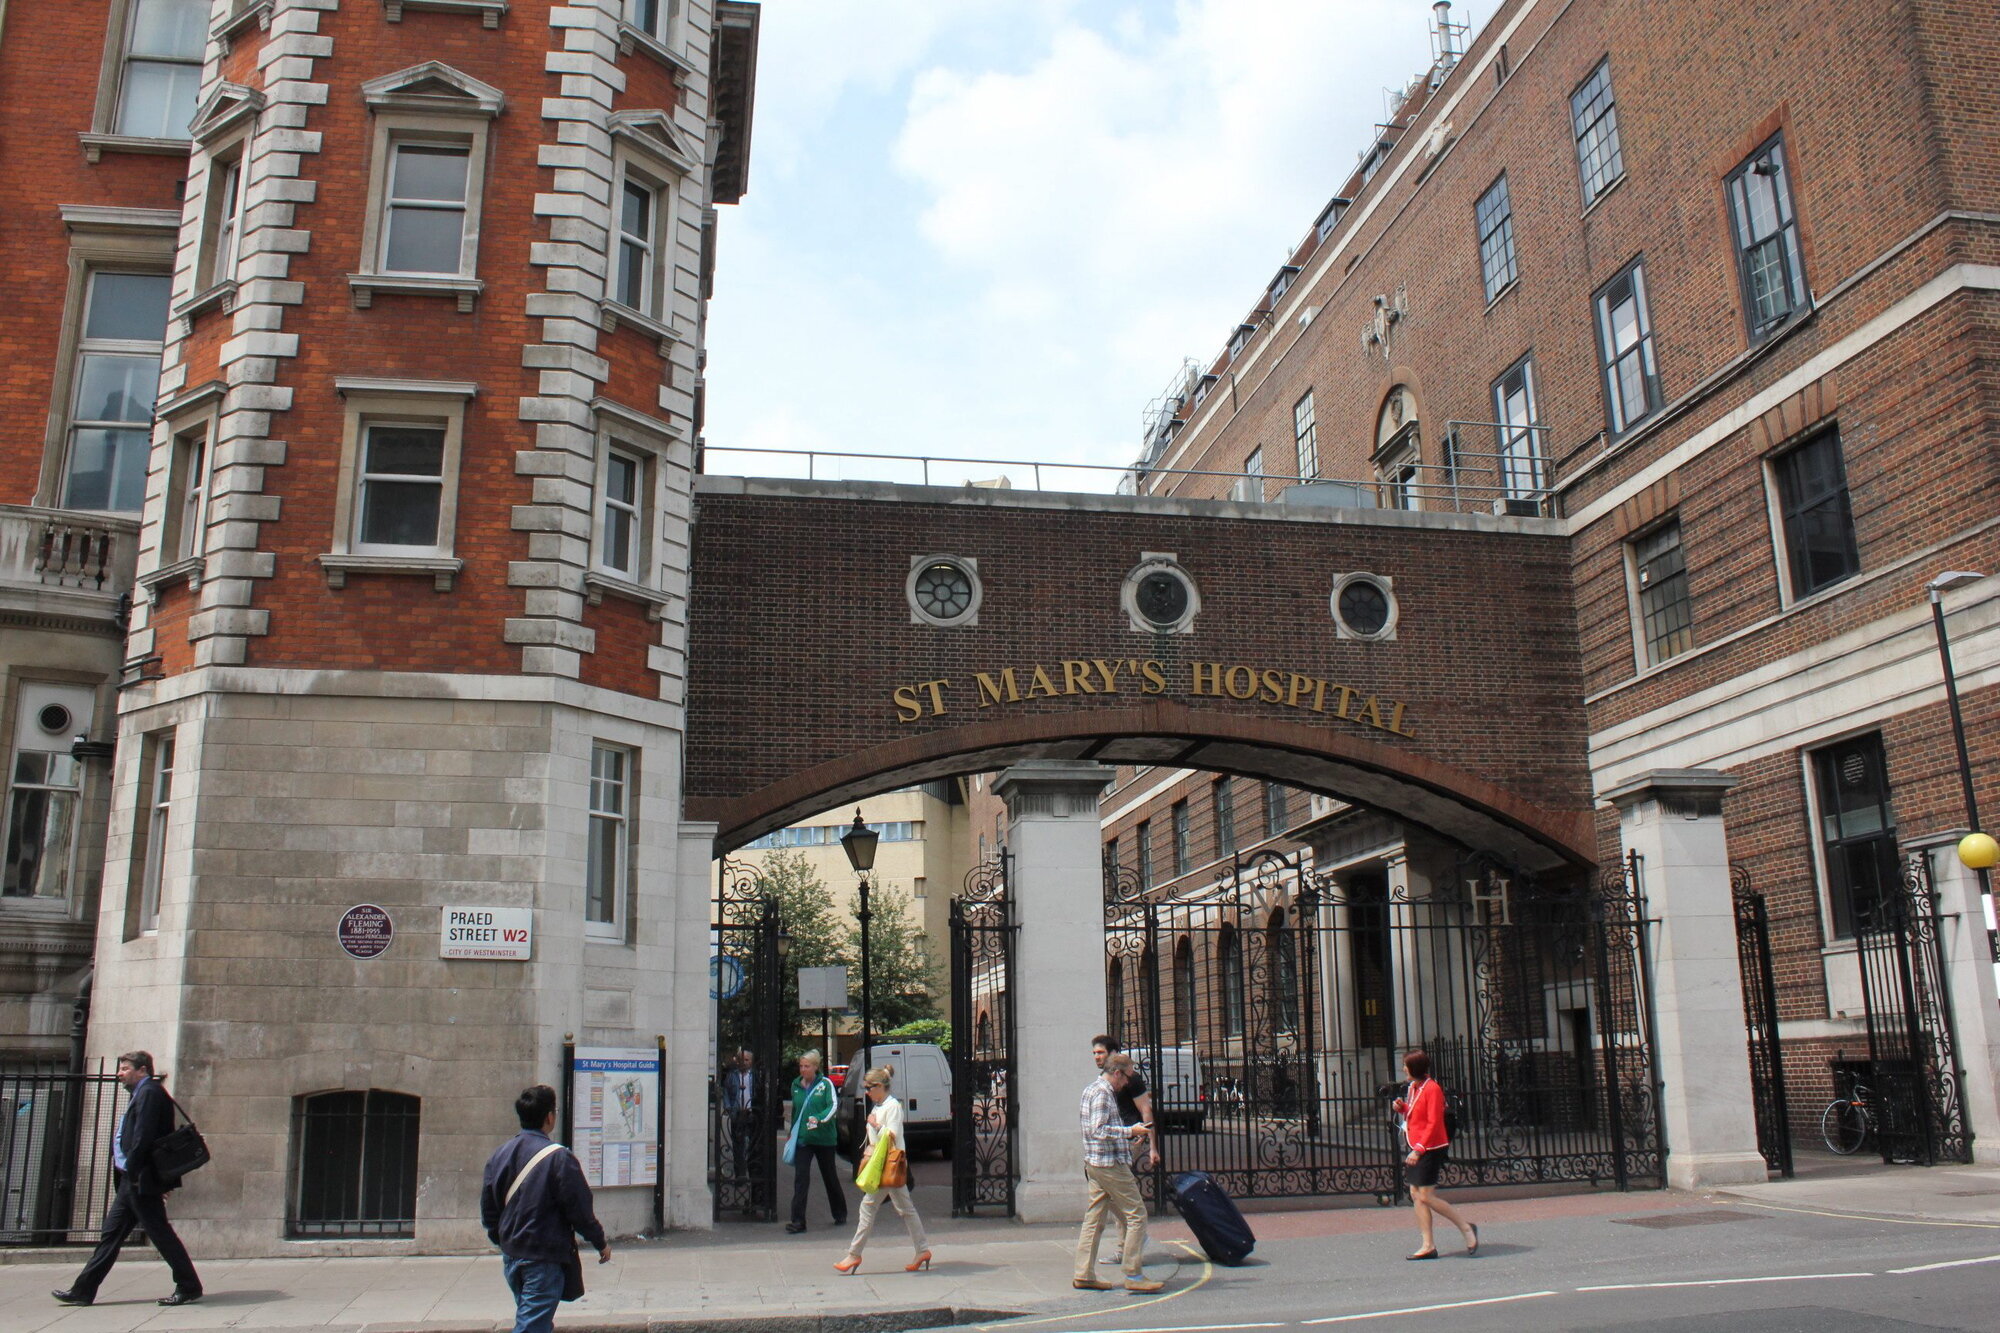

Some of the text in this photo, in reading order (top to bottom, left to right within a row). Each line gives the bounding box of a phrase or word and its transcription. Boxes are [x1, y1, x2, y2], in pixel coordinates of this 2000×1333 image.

[893, 659, 1416, 738] ST MARY'S HOSPITAL
[348, 920, 383, 928] FLEMING
[450, 912, 493, 925] PRAED
[449, 927, 528, 942] STREET W2
[448, 948, 462, 956] CITY
[473, 949, 517, 957] WESTMINSTER
[582, 1060, 655, 1070] St Mary's Hospital Guide
